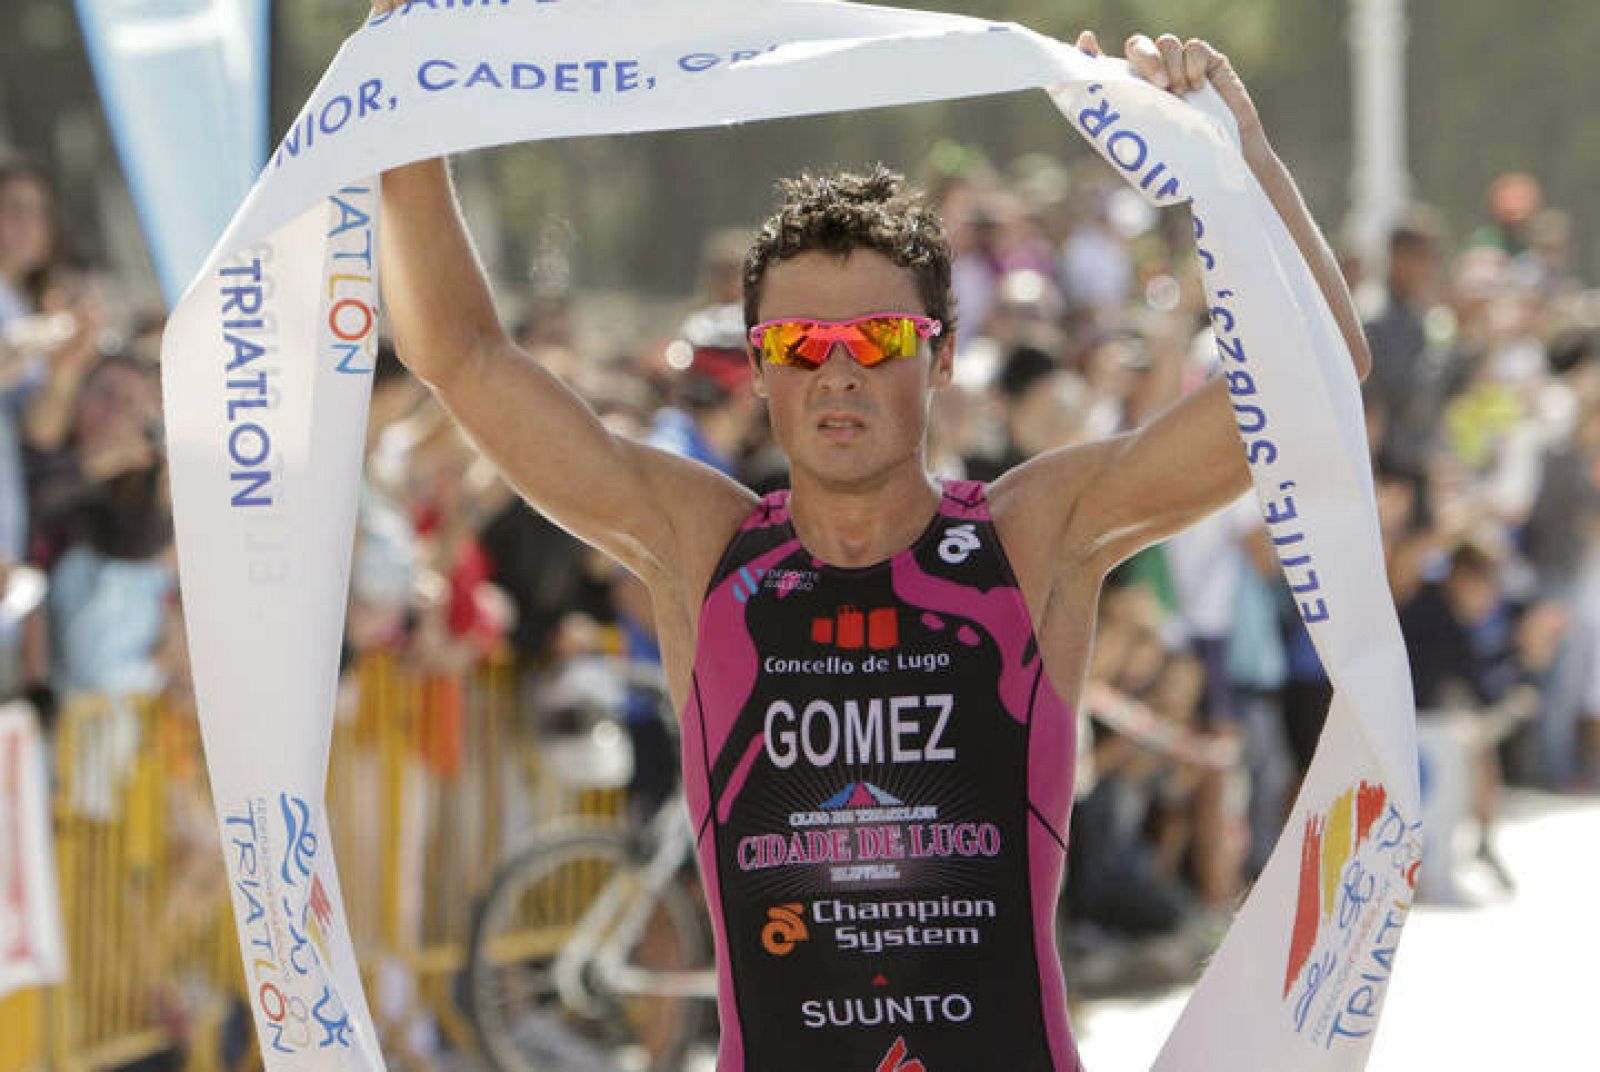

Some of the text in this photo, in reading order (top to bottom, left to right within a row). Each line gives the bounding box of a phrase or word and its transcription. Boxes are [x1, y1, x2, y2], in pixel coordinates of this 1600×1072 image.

[417, 59, 656, 92] CADETE,
[219, 257, 272, 508] TRIATLON
[763, 651, 951, 675] Concello de Lugo
[763, 693, 956, 769] GOMEZ
[737, 822, 1001, 871] CIDADE DE LUGO
[812, 896, 997, 924] Champion
[834, 925, 980, 953] System
[801, 993, 972, 1028] SUUNTO
